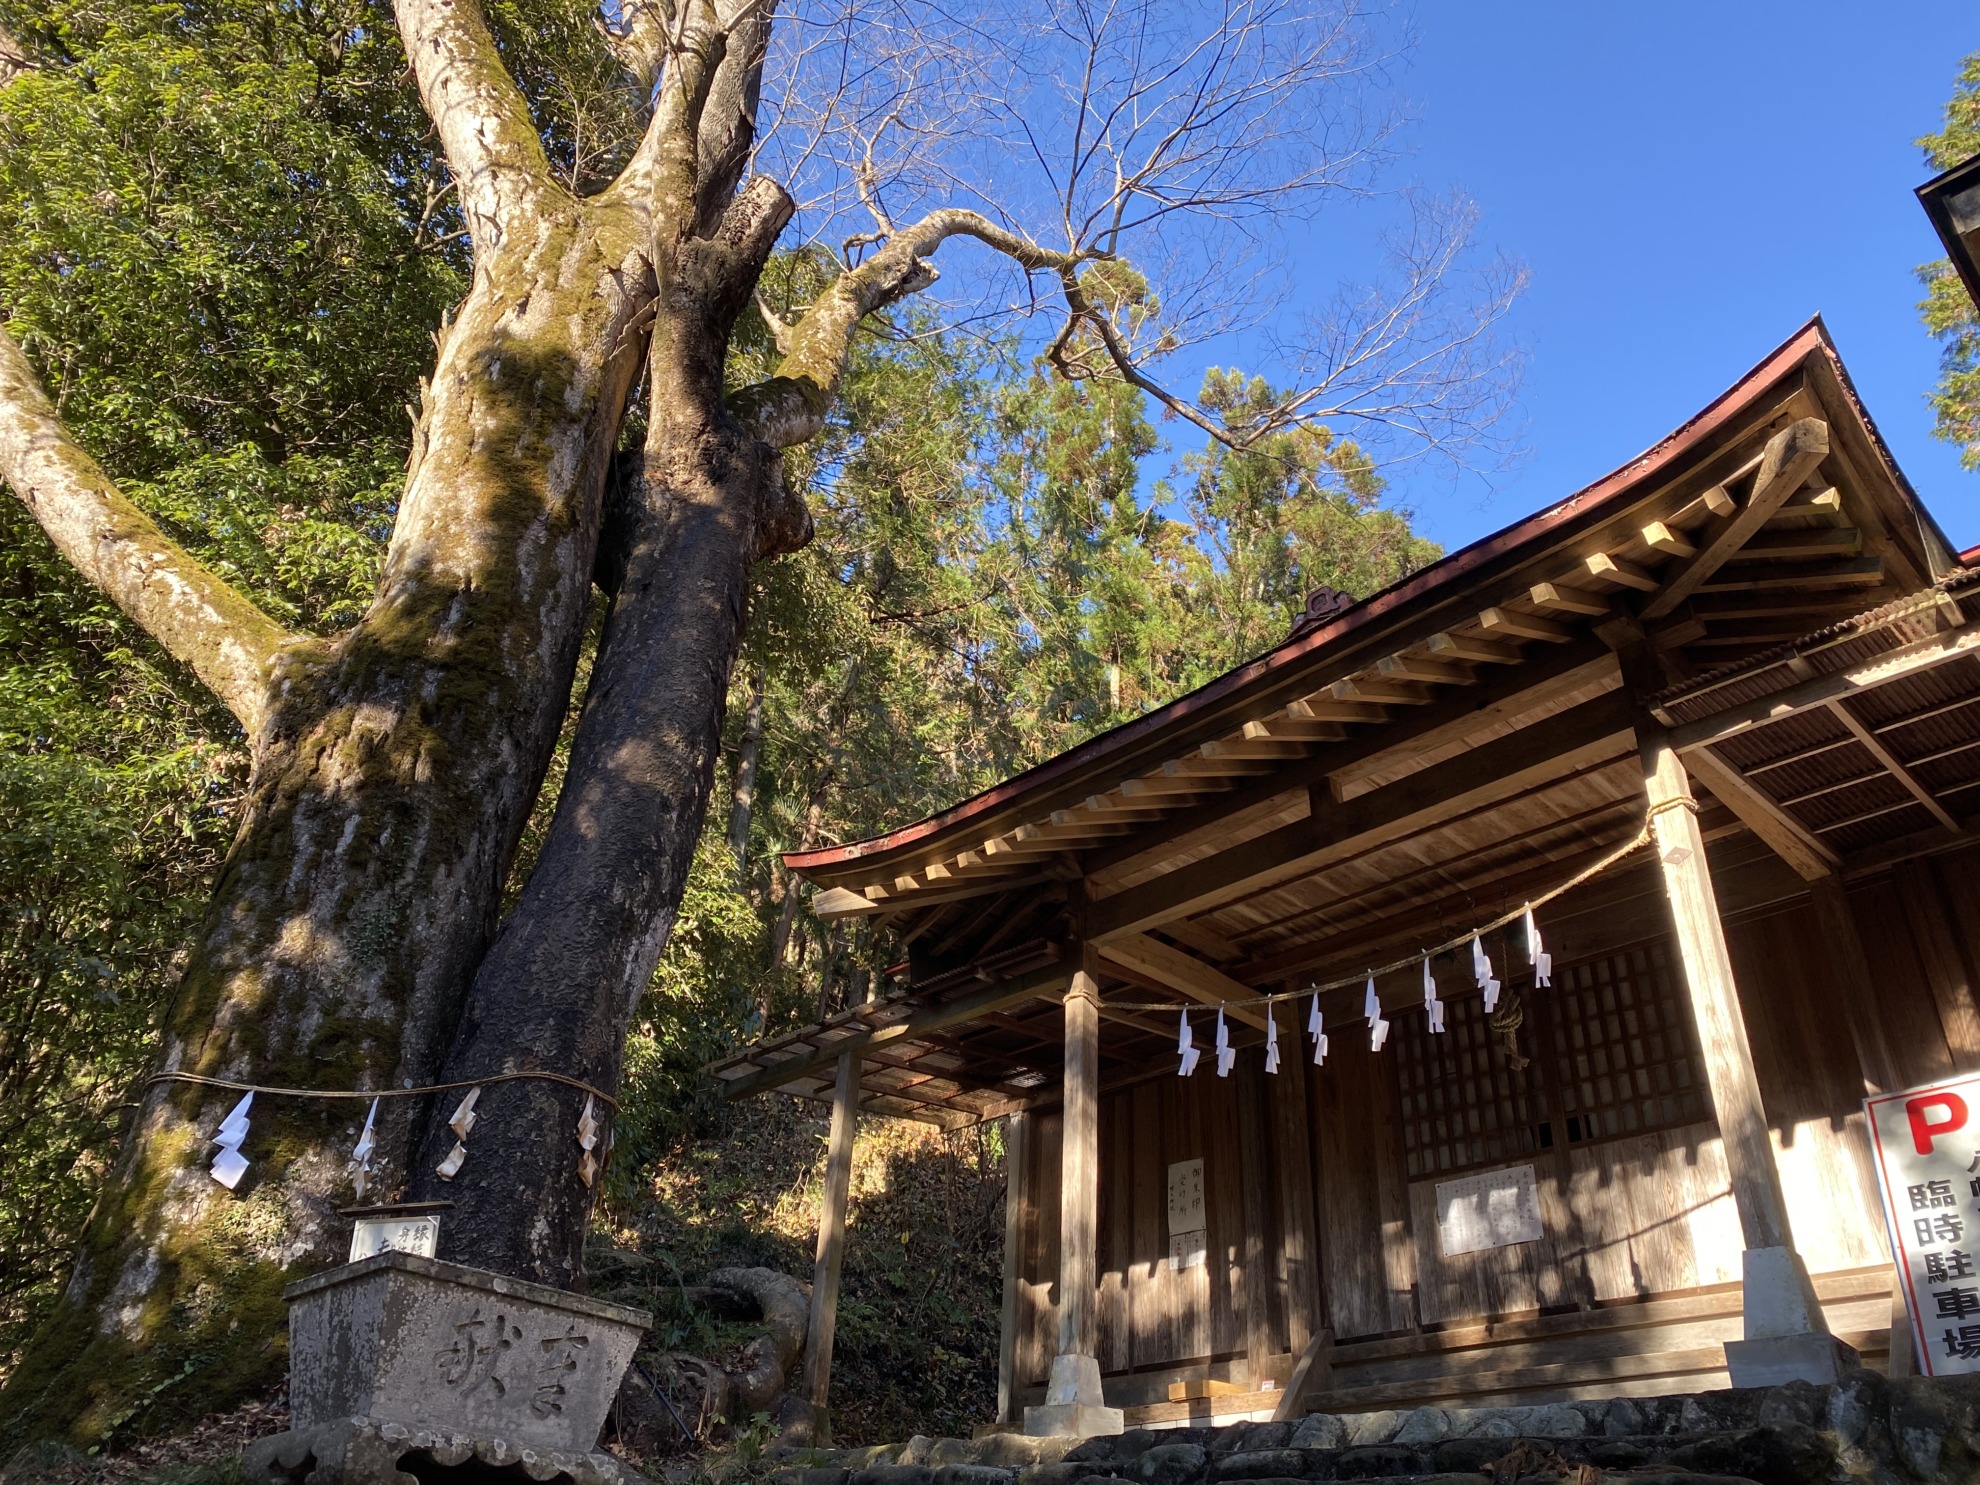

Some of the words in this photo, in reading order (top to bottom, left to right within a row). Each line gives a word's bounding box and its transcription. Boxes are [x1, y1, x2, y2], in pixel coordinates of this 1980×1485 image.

[1905, 1092, 1969, 1156] P
[1192, 1167, 1202, 1211] 御朱印
